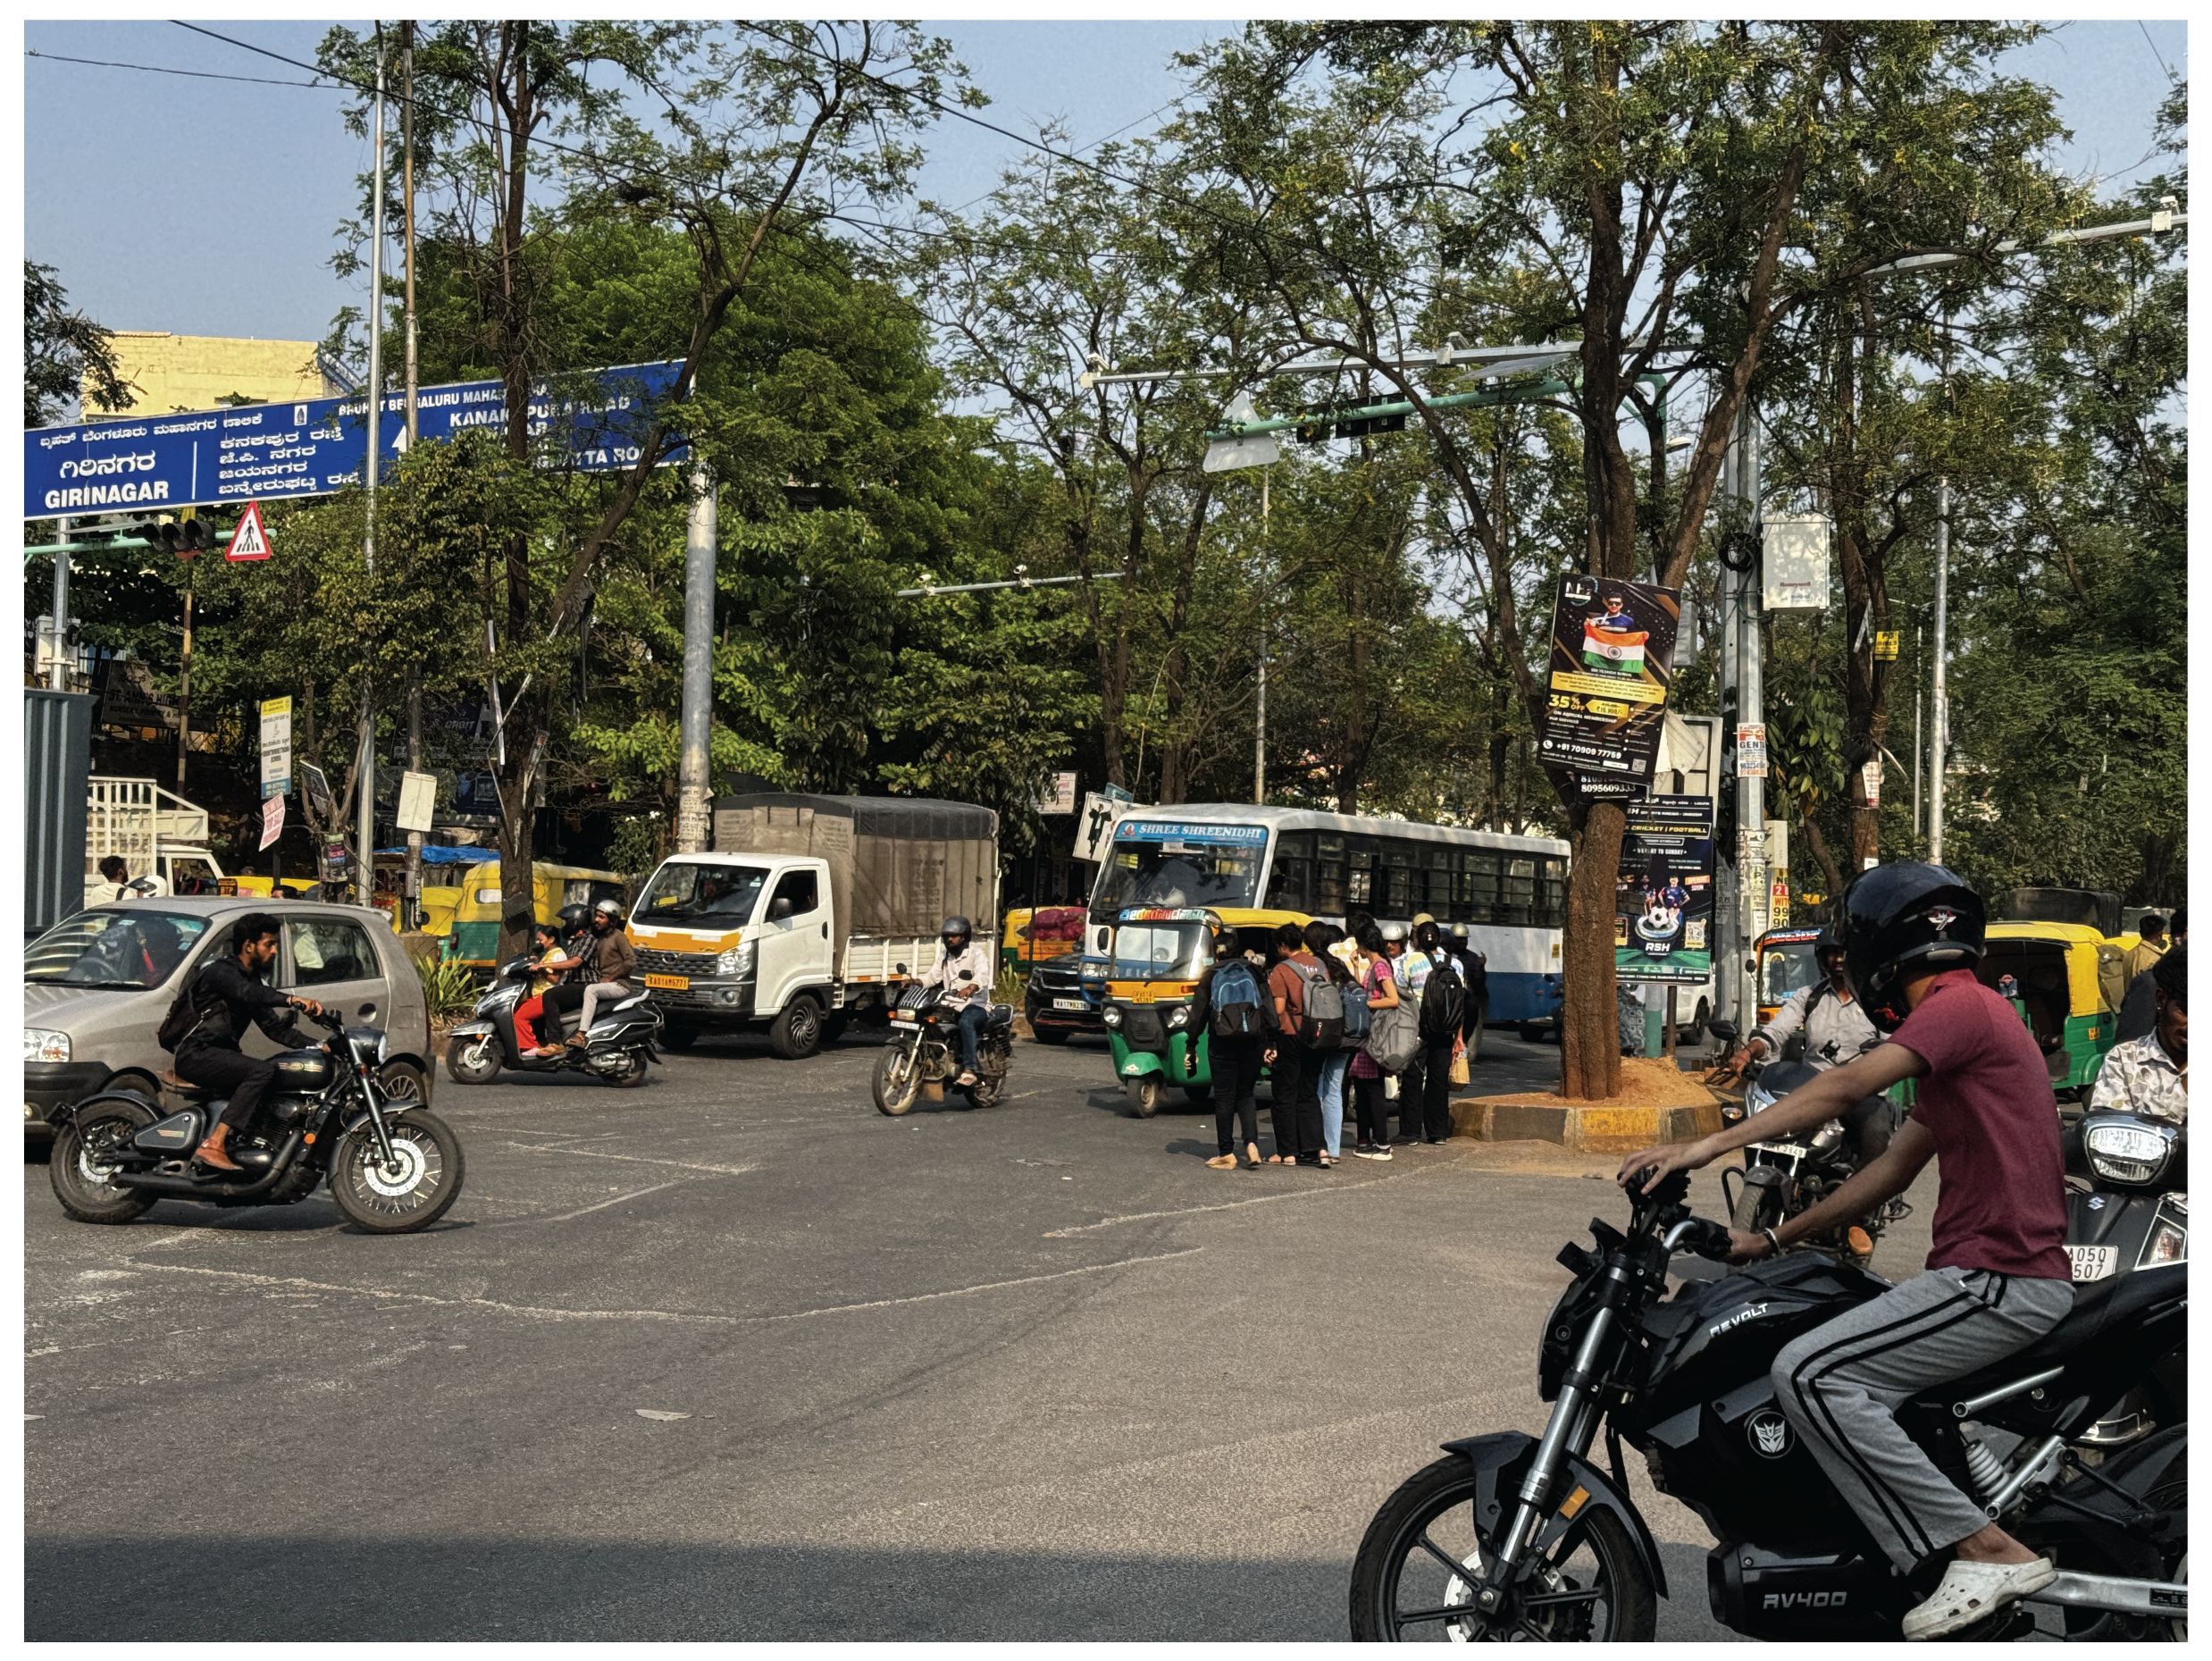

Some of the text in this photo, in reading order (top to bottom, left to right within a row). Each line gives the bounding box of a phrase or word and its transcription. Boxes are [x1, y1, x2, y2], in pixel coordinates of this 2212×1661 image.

[339, 399, 386, 416] BRUHT
[154, 418, 217, 435] ಮಹಾನಗರ
[223, 413, 263, 428] ಪಾಲಿಕೆ
[220, 426, 345, 447] ಕನಕಪುರ ರಸ್ತೆ
[270, 444, 316, 460] ನಗರ
[59, 449, 155, 479] ಗಿರಿನಗರ
[219, 460, 308, 479] ಜಯನಗರ
[45, 481, 169, 509] GIRINAGAR
[1548, 694, 1580, 709] 35 %
[1556, 742, 1570, 751] +91
[1571, 745, 1596, 756] 70909
[1138, 824, 1262, 839] SHREE SHREENIDHI
[1631, 825, 1663, 833] CRICKET
[1775, 885, 1782, 895] 2
[1645, 943, 1671, 952] RSH
[1709, 1303, 1768, 1338] REVOLT
[1763, 1591, 1848, 1609] RV400
